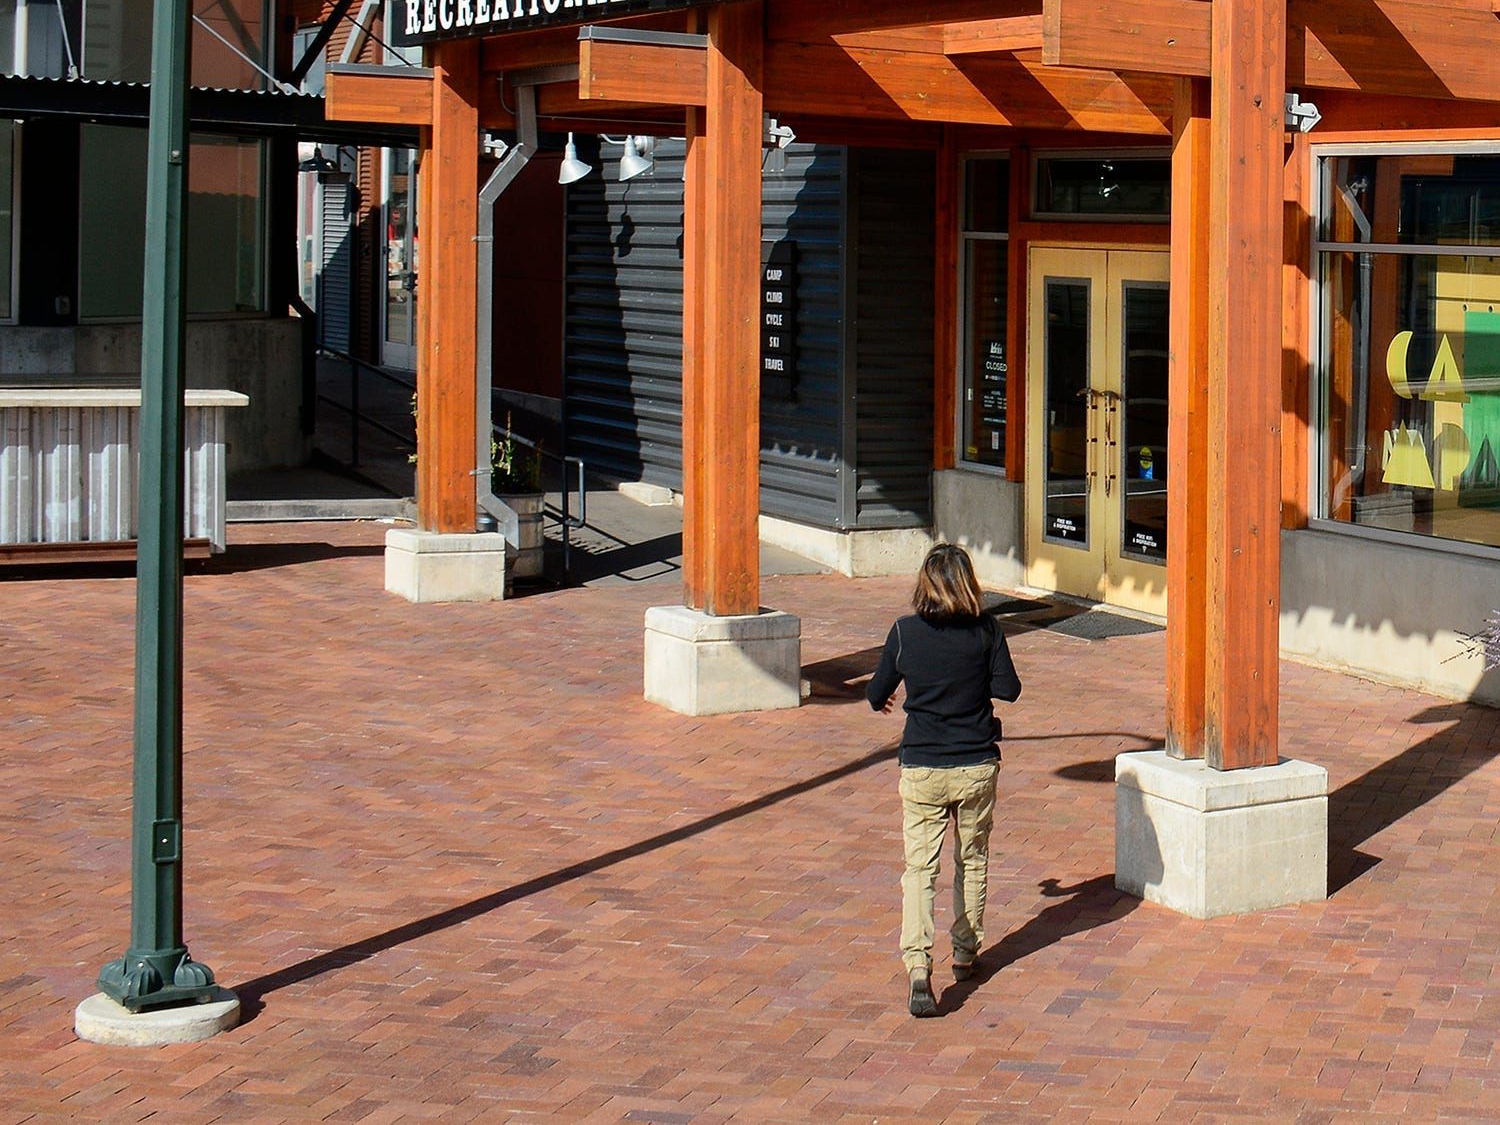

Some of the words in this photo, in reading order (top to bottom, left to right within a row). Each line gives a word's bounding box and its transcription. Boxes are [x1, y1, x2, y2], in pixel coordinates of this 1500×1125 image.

[766, 269, 783, 281] CAMP
[766, 291, 783, 304] CLIMB
[765, 313, 783, 326] CYCLE
[769, 336, 780, 348] SKI
[764, 358, 784, 371] TRAVEL
[985, 361, 1008, 372] CLOSED
